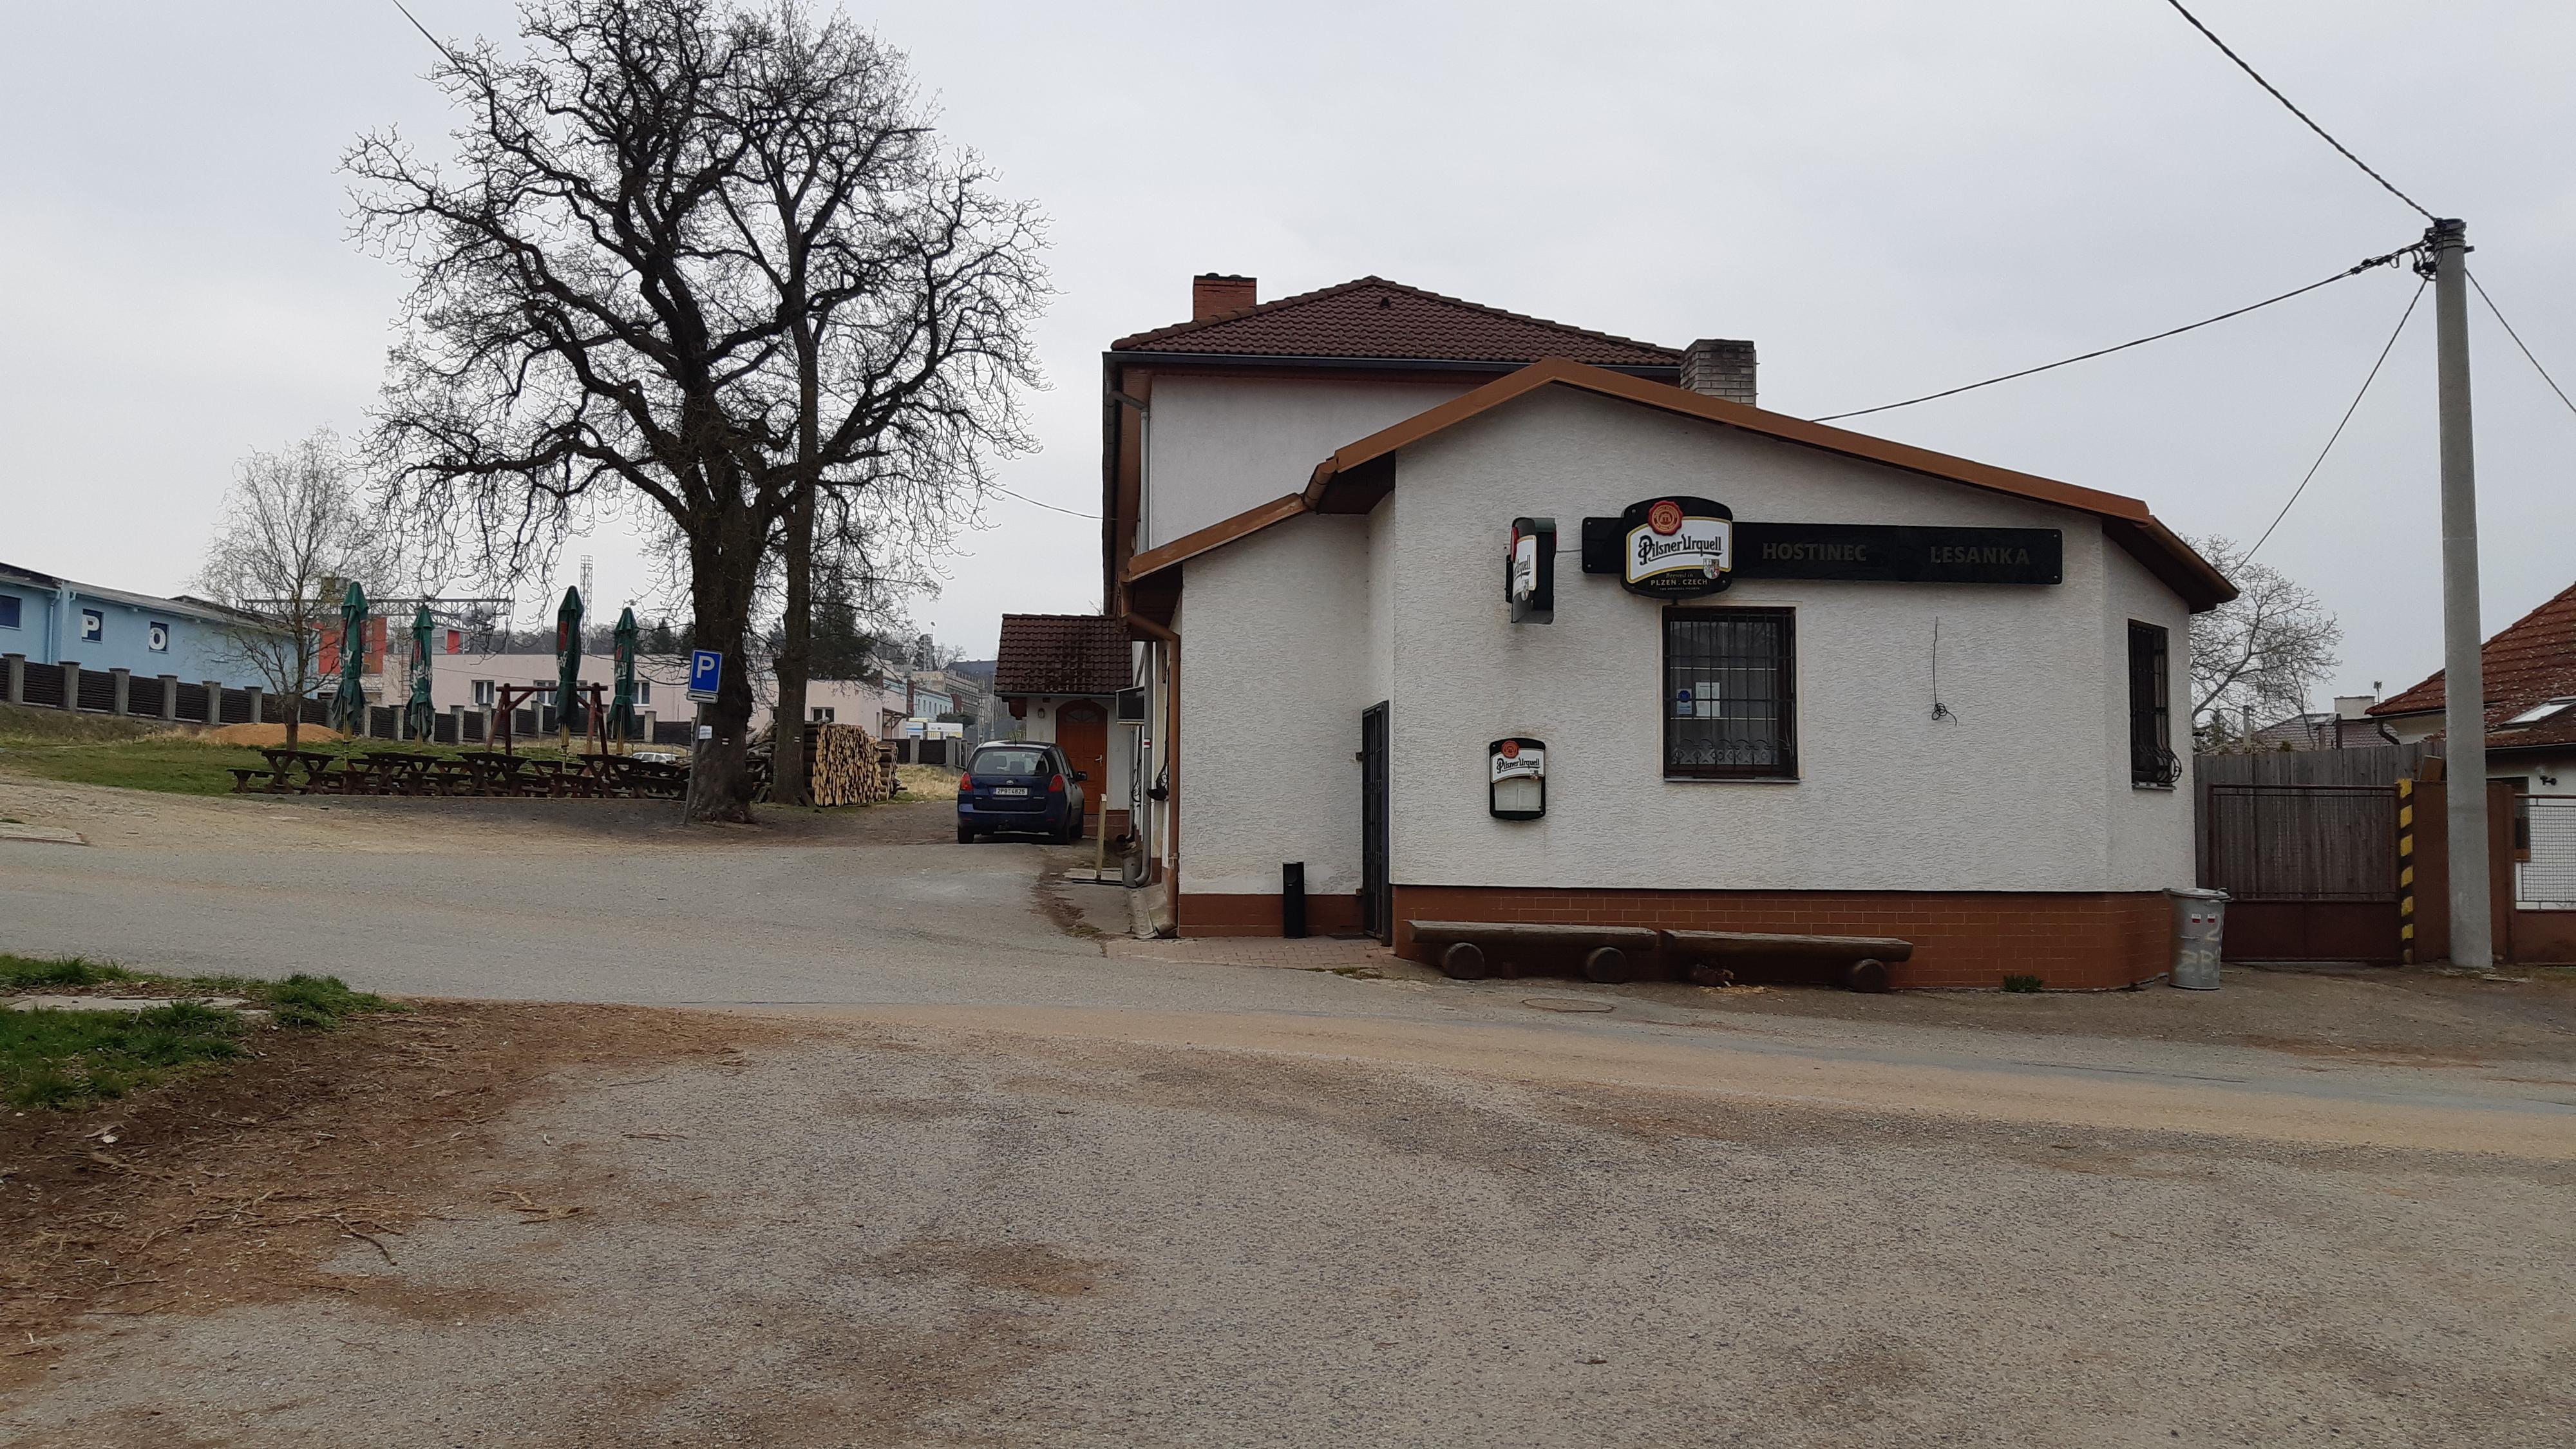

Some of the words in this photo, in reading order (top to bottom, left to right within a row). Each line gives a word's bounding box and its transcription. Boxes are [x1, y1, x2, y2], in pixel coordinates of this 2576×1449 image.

[1638, 535, 1682, 565] Pilsner
[1681, 533, 1721, 557] Urquell
[1762, 542, 1867, 562] HOSTINEC
[1931, 545, 2031, 565] LESANKA
[82, 614, 100, 638] P
[697, 655, 715, 678] P
[1497, 758, 1519, 774] Pilsner
[1519, 757, 1540, 769] Urquell
